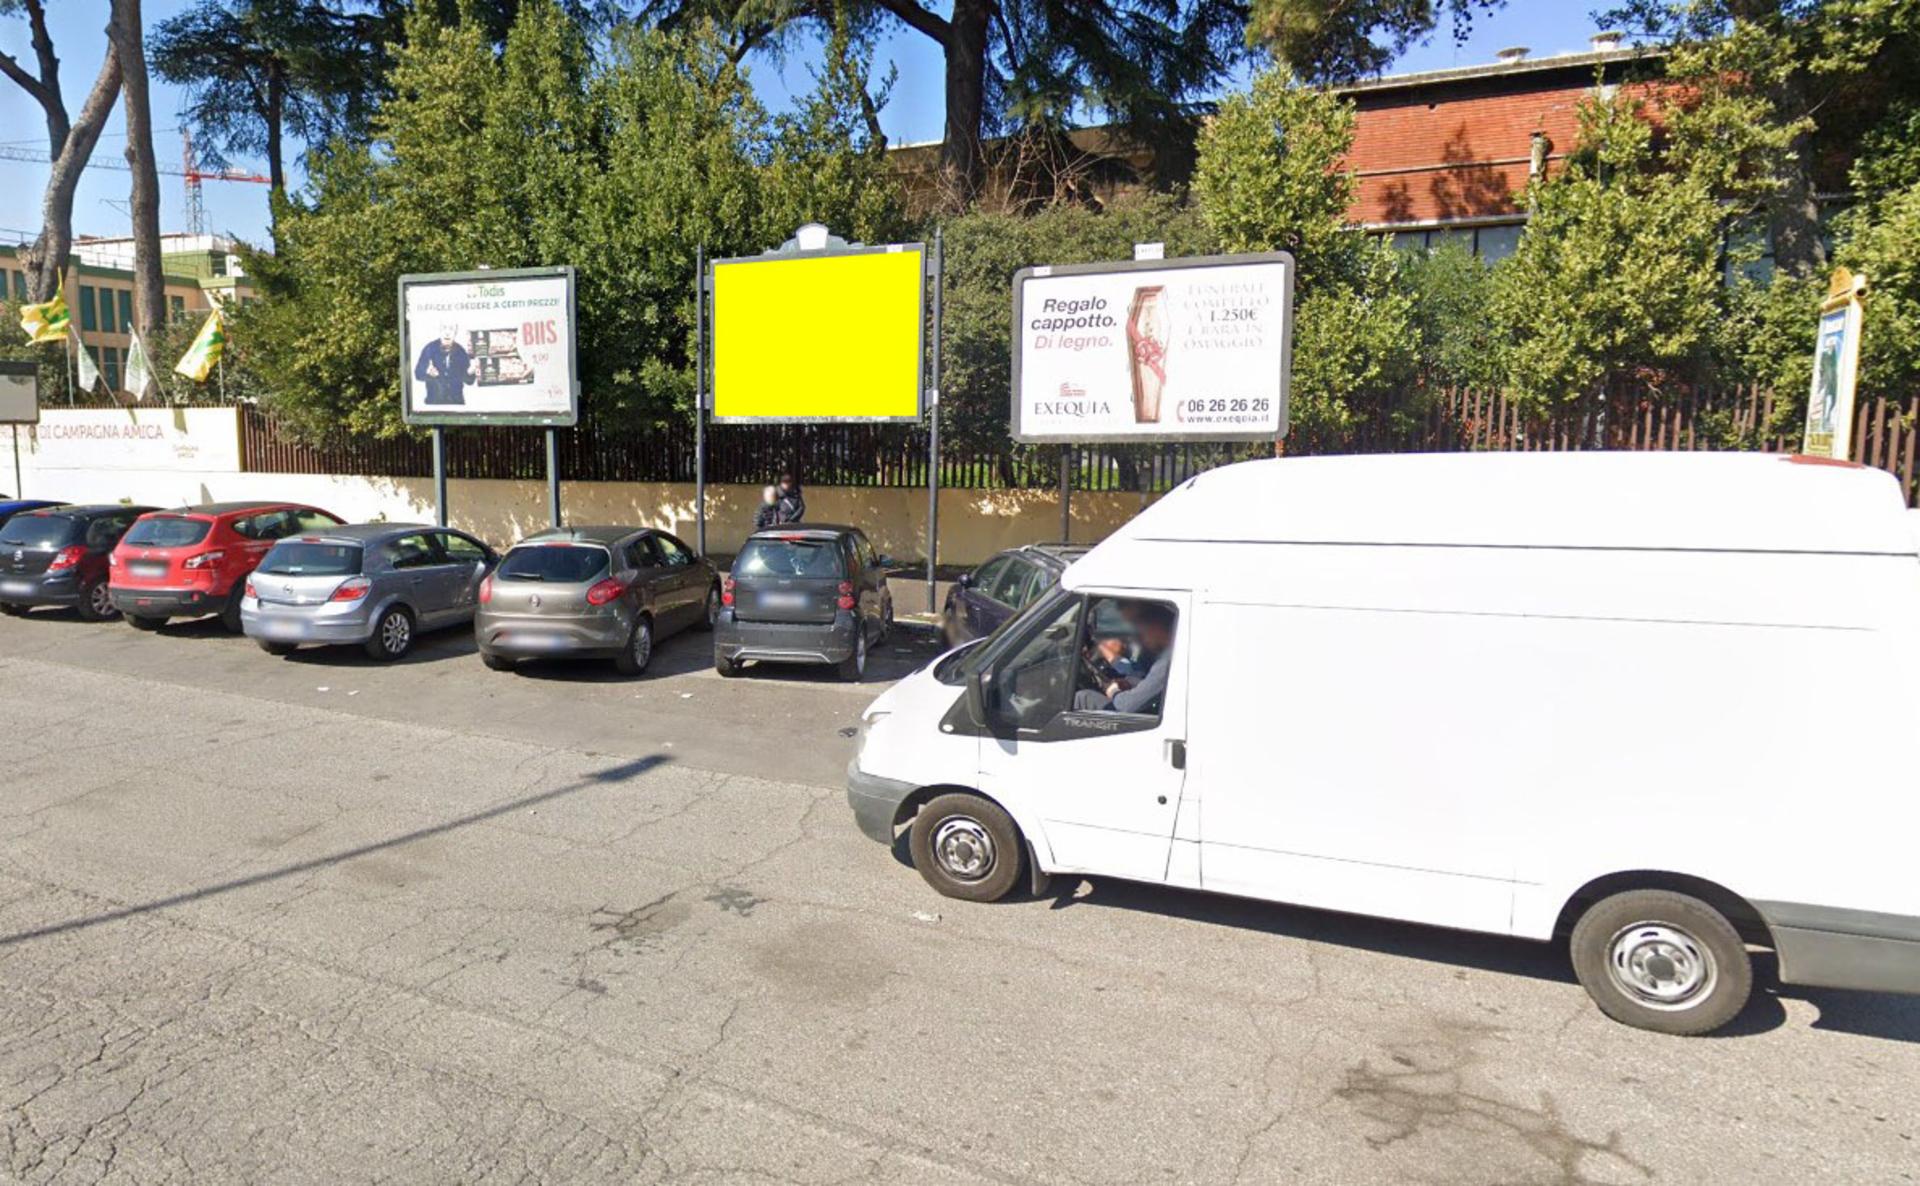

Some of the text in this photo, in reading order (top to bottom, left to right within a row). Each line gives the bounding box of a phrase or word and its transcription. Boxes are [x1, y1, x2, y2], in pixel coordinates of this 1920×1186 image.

[1043, 296, 1107, 315] Regalo
[1210, 307, 1258, 322] 1.250€
[1031, 313, 1117, 332] cappotto.
[1034, 334, 1113, 352] Di legno.
[1034, 401, 1111, 417] EXEQUIA
[1188, 398, 1270, 413] 06 26 26 26
[40, 425, 52, 439] DI
[53, 424, 120, 439] CAMPAGNA
[122, 424, 163, 439] AMICA
[1063, 717, 1120, 731] TRANSIT
